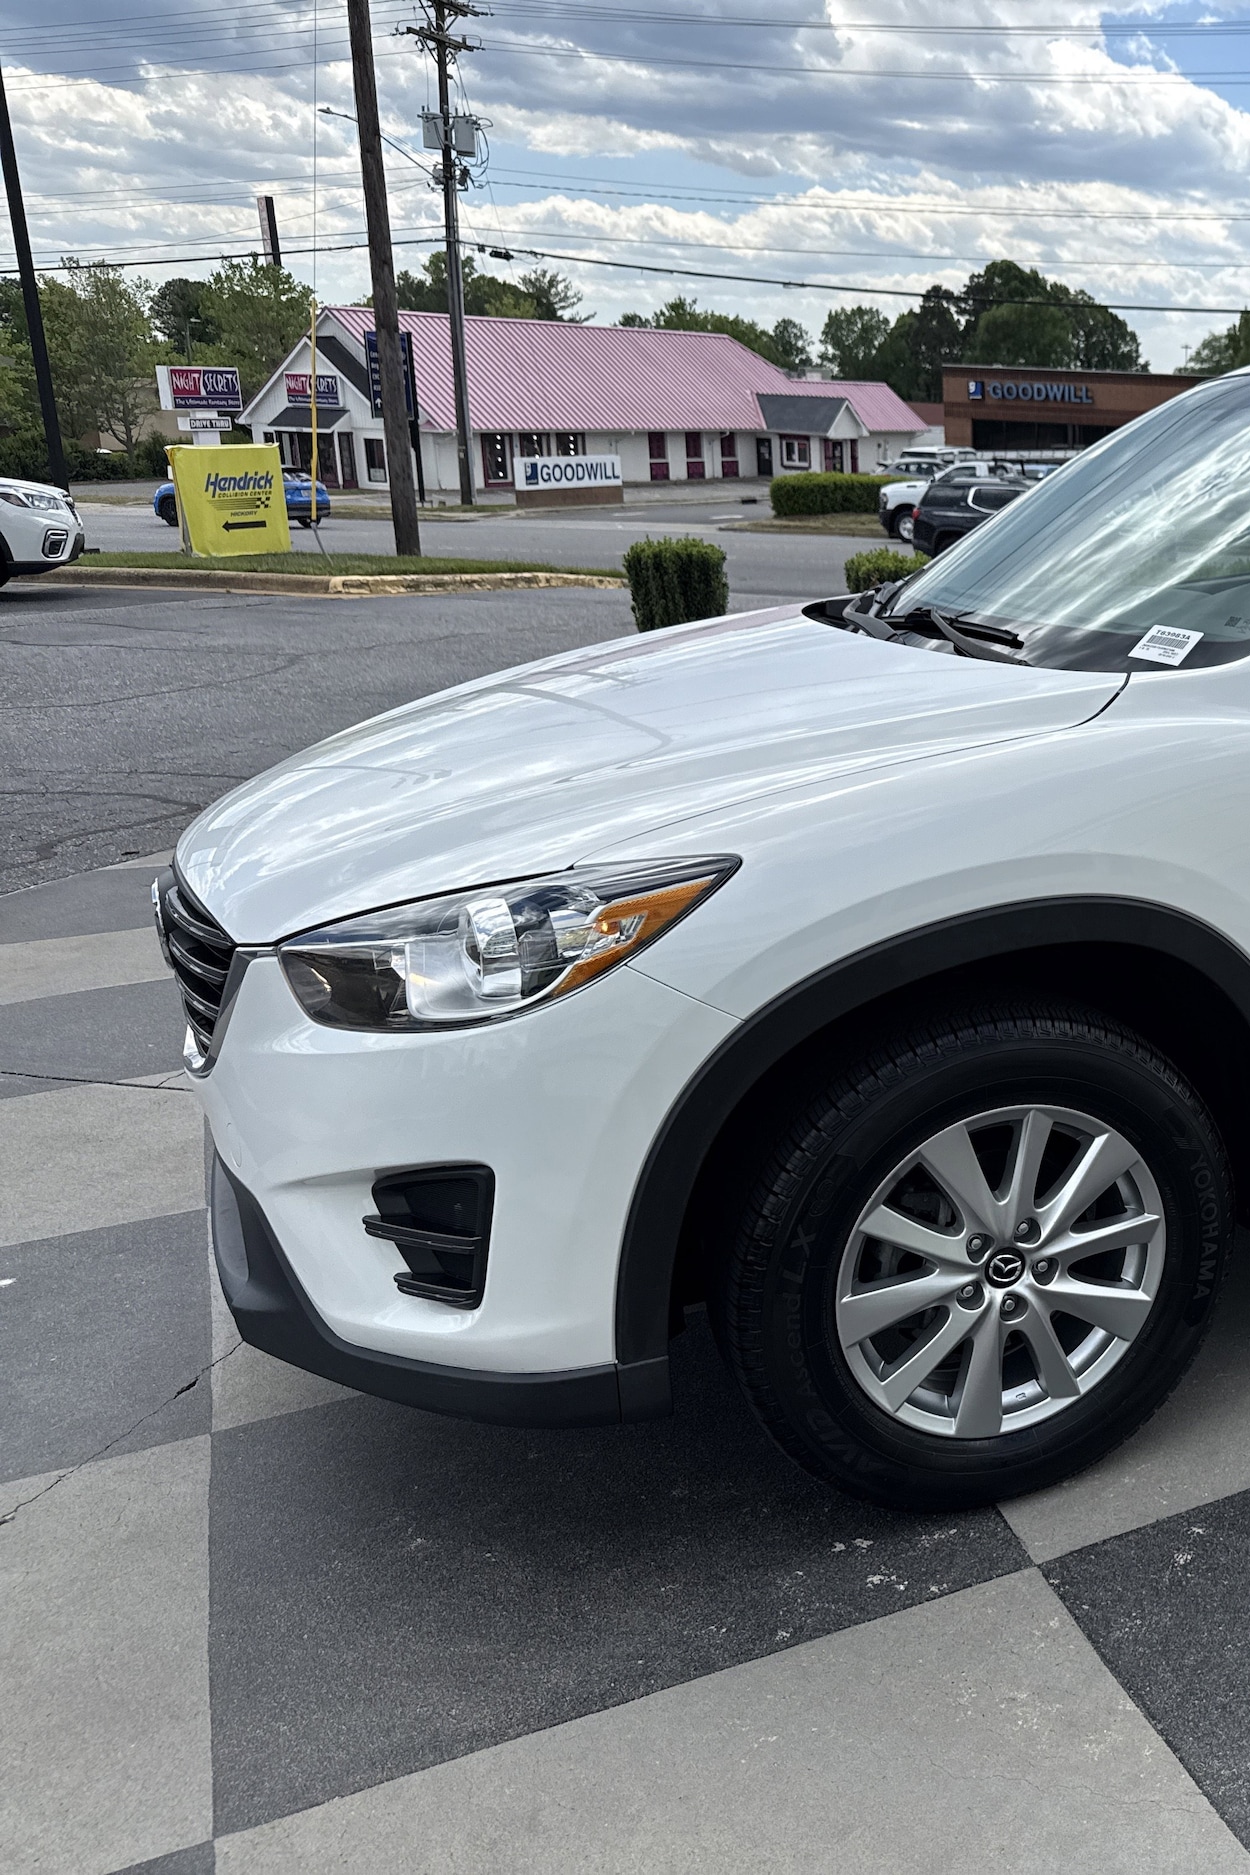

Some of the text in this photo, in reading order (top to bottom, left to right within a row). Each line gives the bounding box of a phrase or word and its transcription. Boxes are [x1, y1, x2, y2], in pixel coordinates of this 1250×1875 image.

[204, 373, 239, 393] SECRETS
[988, 381, 1093, 404] GOODWILL
[190, 419, 230, 428] DRIVE THRU
[205, 471, 274, 498] Hendrick
[540, 462, 620, 483] GOODWILL
[1190, 1153, 1220, 1301] YOKOHAMA
[782, 1223, 818, 1285] LX
[783, 1292, 819, 1398] Ascend
